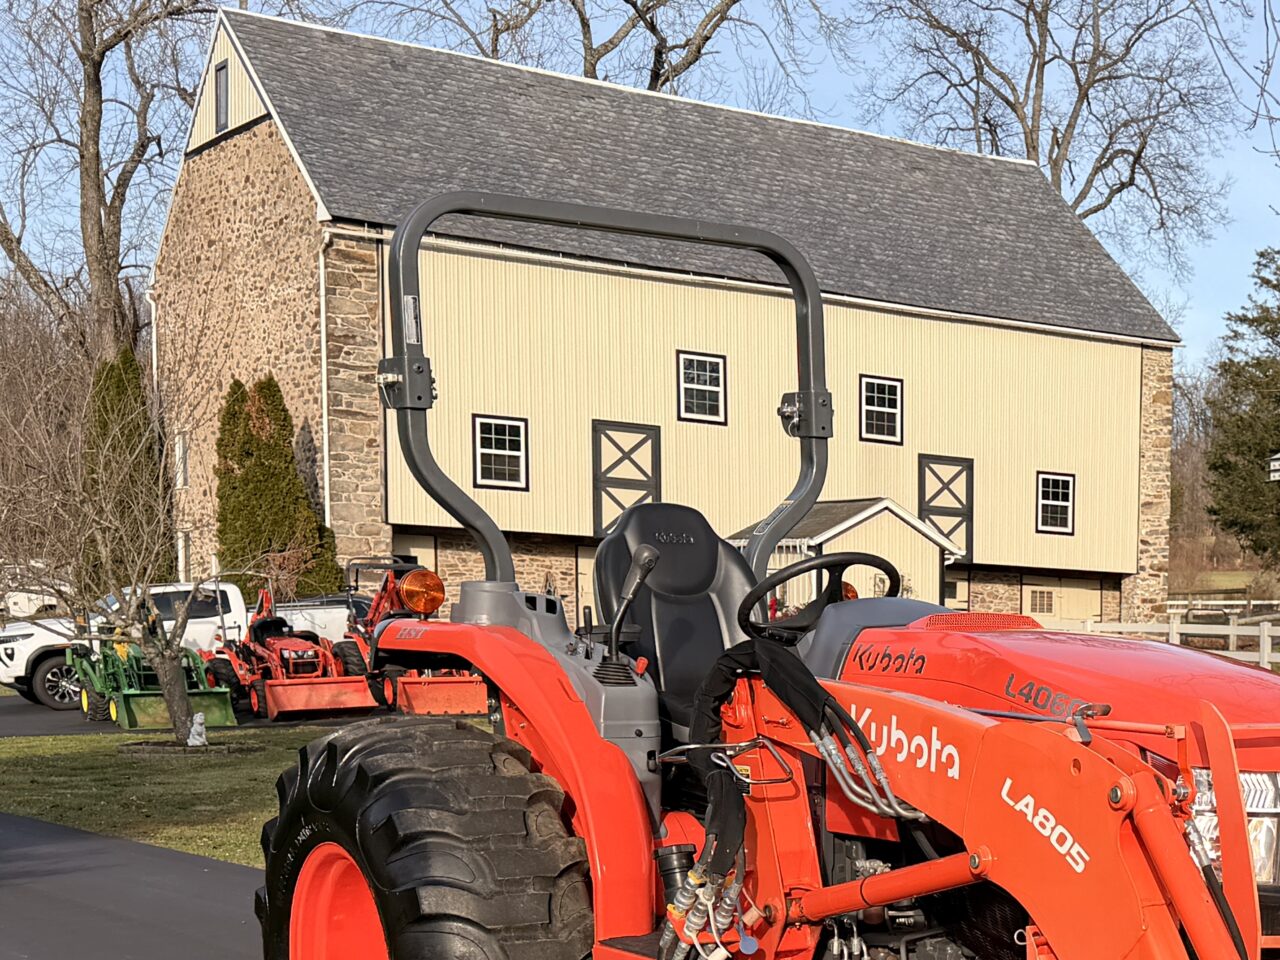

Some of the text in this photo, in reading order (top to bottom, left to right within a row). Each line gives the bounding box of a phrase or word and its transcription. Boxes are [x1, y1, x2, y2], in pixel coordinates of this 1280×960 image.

[655, 532, 694, 544] Kubota
[852, 644, 926, 674] Kubota
[850, 703, 960, 780] Kubota
[1001, 777, 1091, 873] LA805
